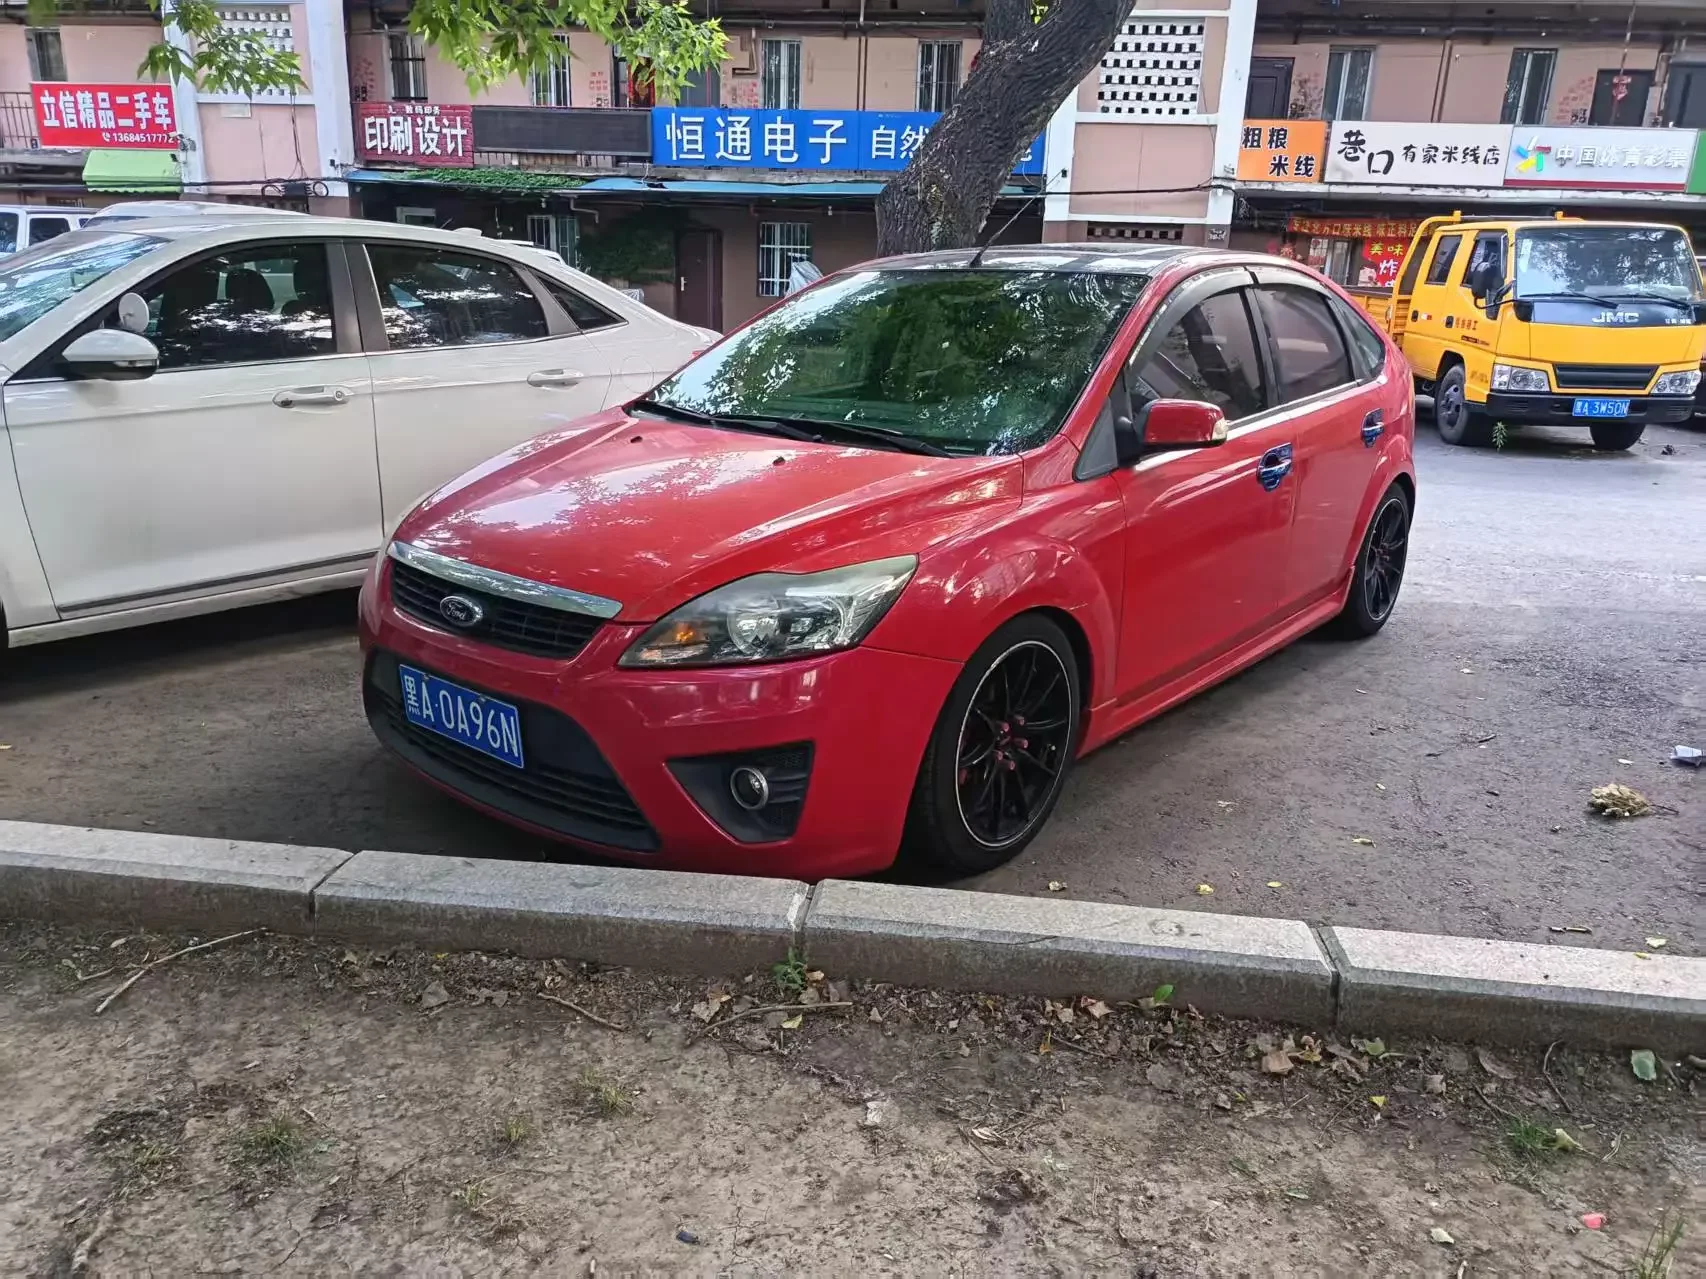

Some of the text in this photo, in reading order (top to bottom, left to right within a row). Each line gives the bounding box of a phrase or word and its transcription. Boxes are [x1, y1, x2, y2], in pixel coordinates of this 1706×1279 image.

[40, 89, 172, 130] 立信精品二手车
[364, 115, 467, 157] 印刷设计
[666, 112, 847, 164] 恒通电子
[1242, 127, 1288, 149] 粗粮
[1337, 129, 1500, 175] 巷口 有家米线店
[1555, 145, 1688, 169] 中国体育彩票
[1269, 155, 1315, 177] 米线
[1369, 242, 1404, 257] 美味
[1379, 258, 1399, 277] 炸
[1592, 311, 1640, 323] JMC
[446, 601, 467, 621] Ford
